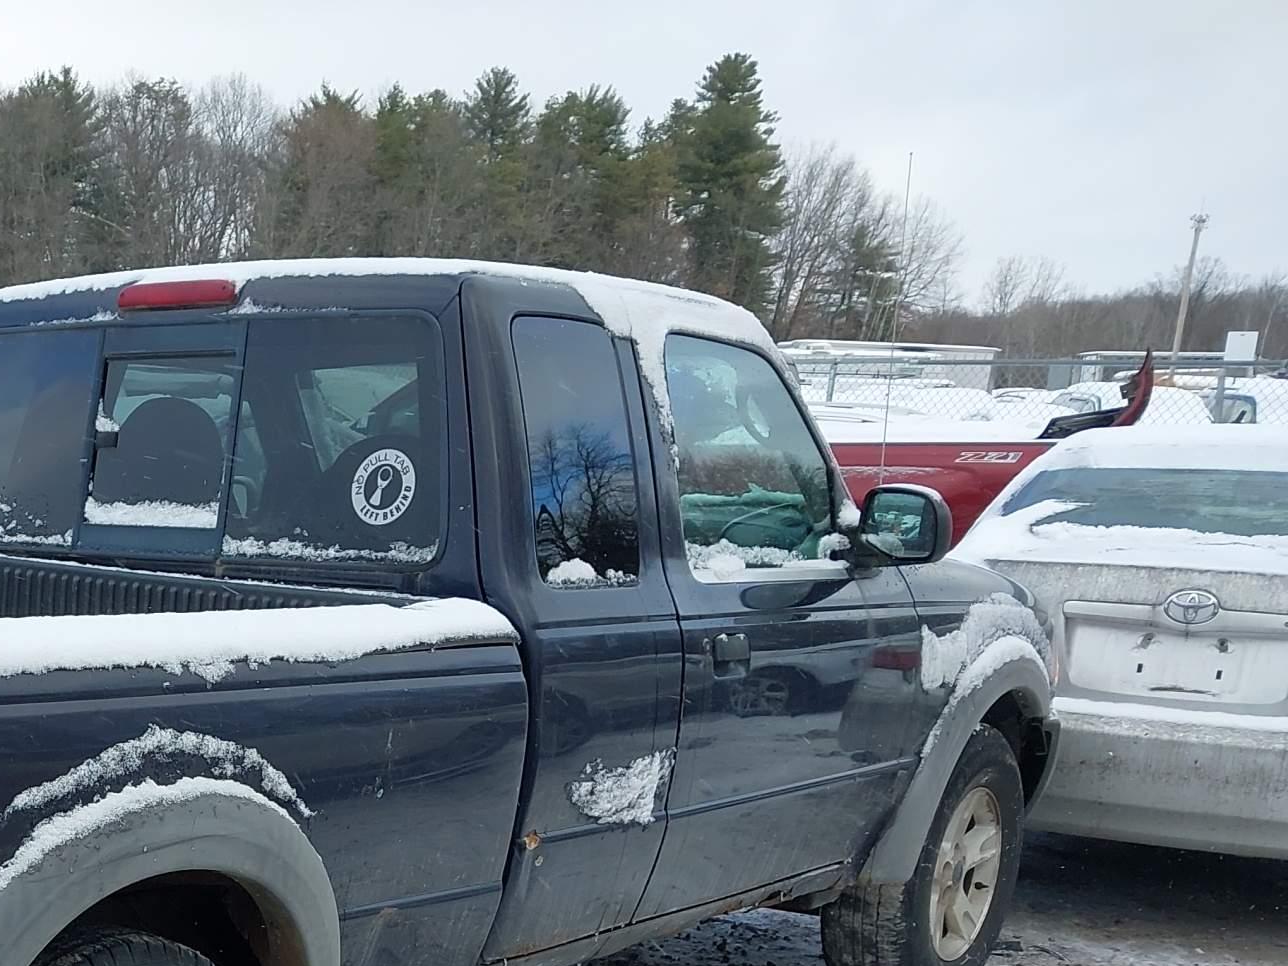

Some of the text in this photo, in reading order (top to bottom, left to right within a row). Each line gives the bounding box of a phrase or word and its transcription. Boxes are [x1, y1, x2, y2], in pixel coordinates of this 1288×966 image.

[355, 452, 410, 495] NO PULL TAB
[360, 486, 412, 521] LEFT BEHIND
